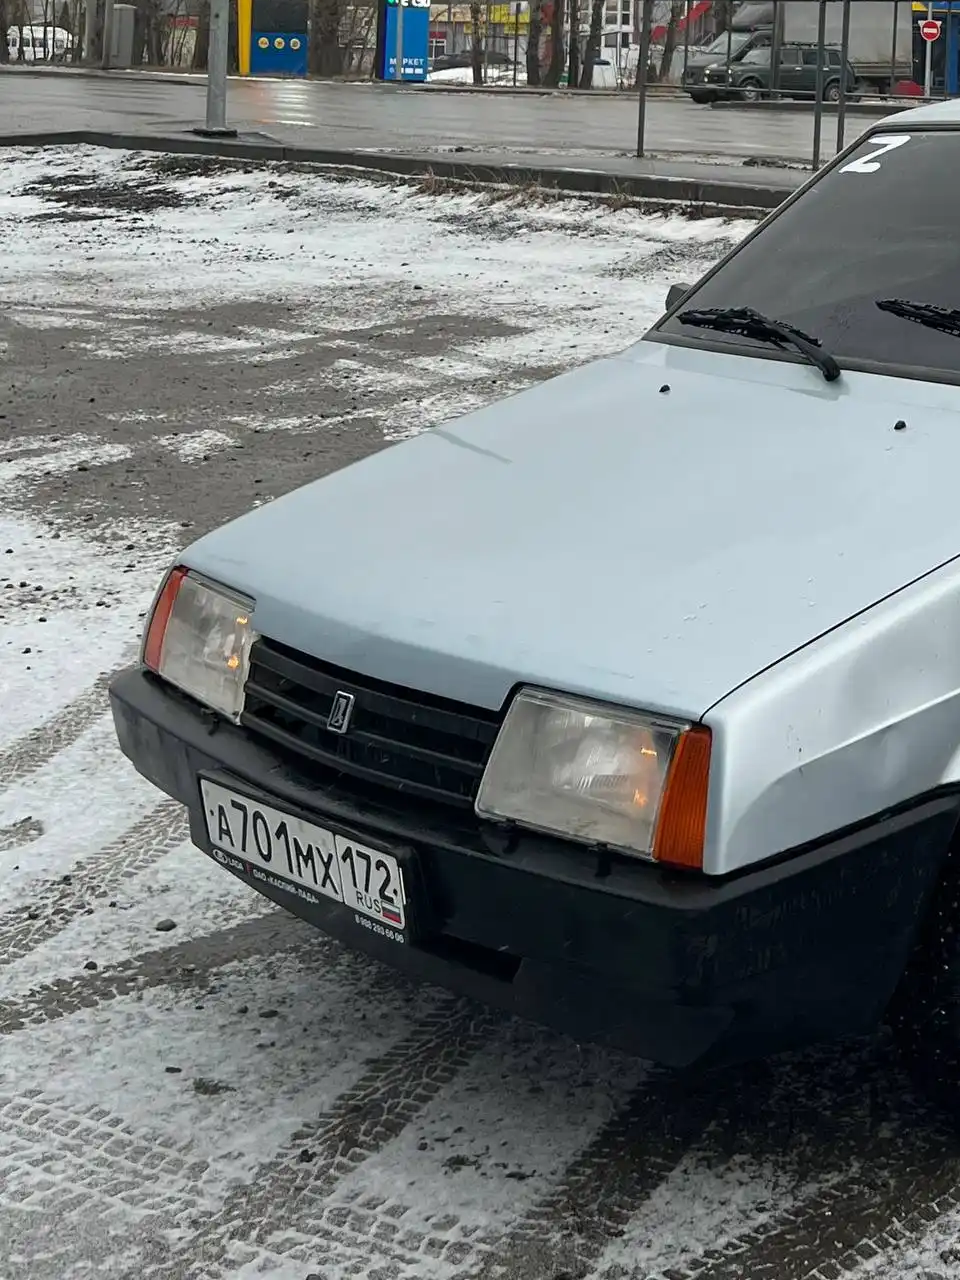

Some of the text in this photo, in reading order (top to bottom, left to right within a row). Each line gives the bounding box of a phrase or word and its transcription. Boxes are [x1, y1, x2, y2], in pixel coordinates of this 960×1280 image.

[389, 57, 425, 66] МРКЕТ
[341, 845, 394, 904] 172
[356, 890, 381, 913] RUS
